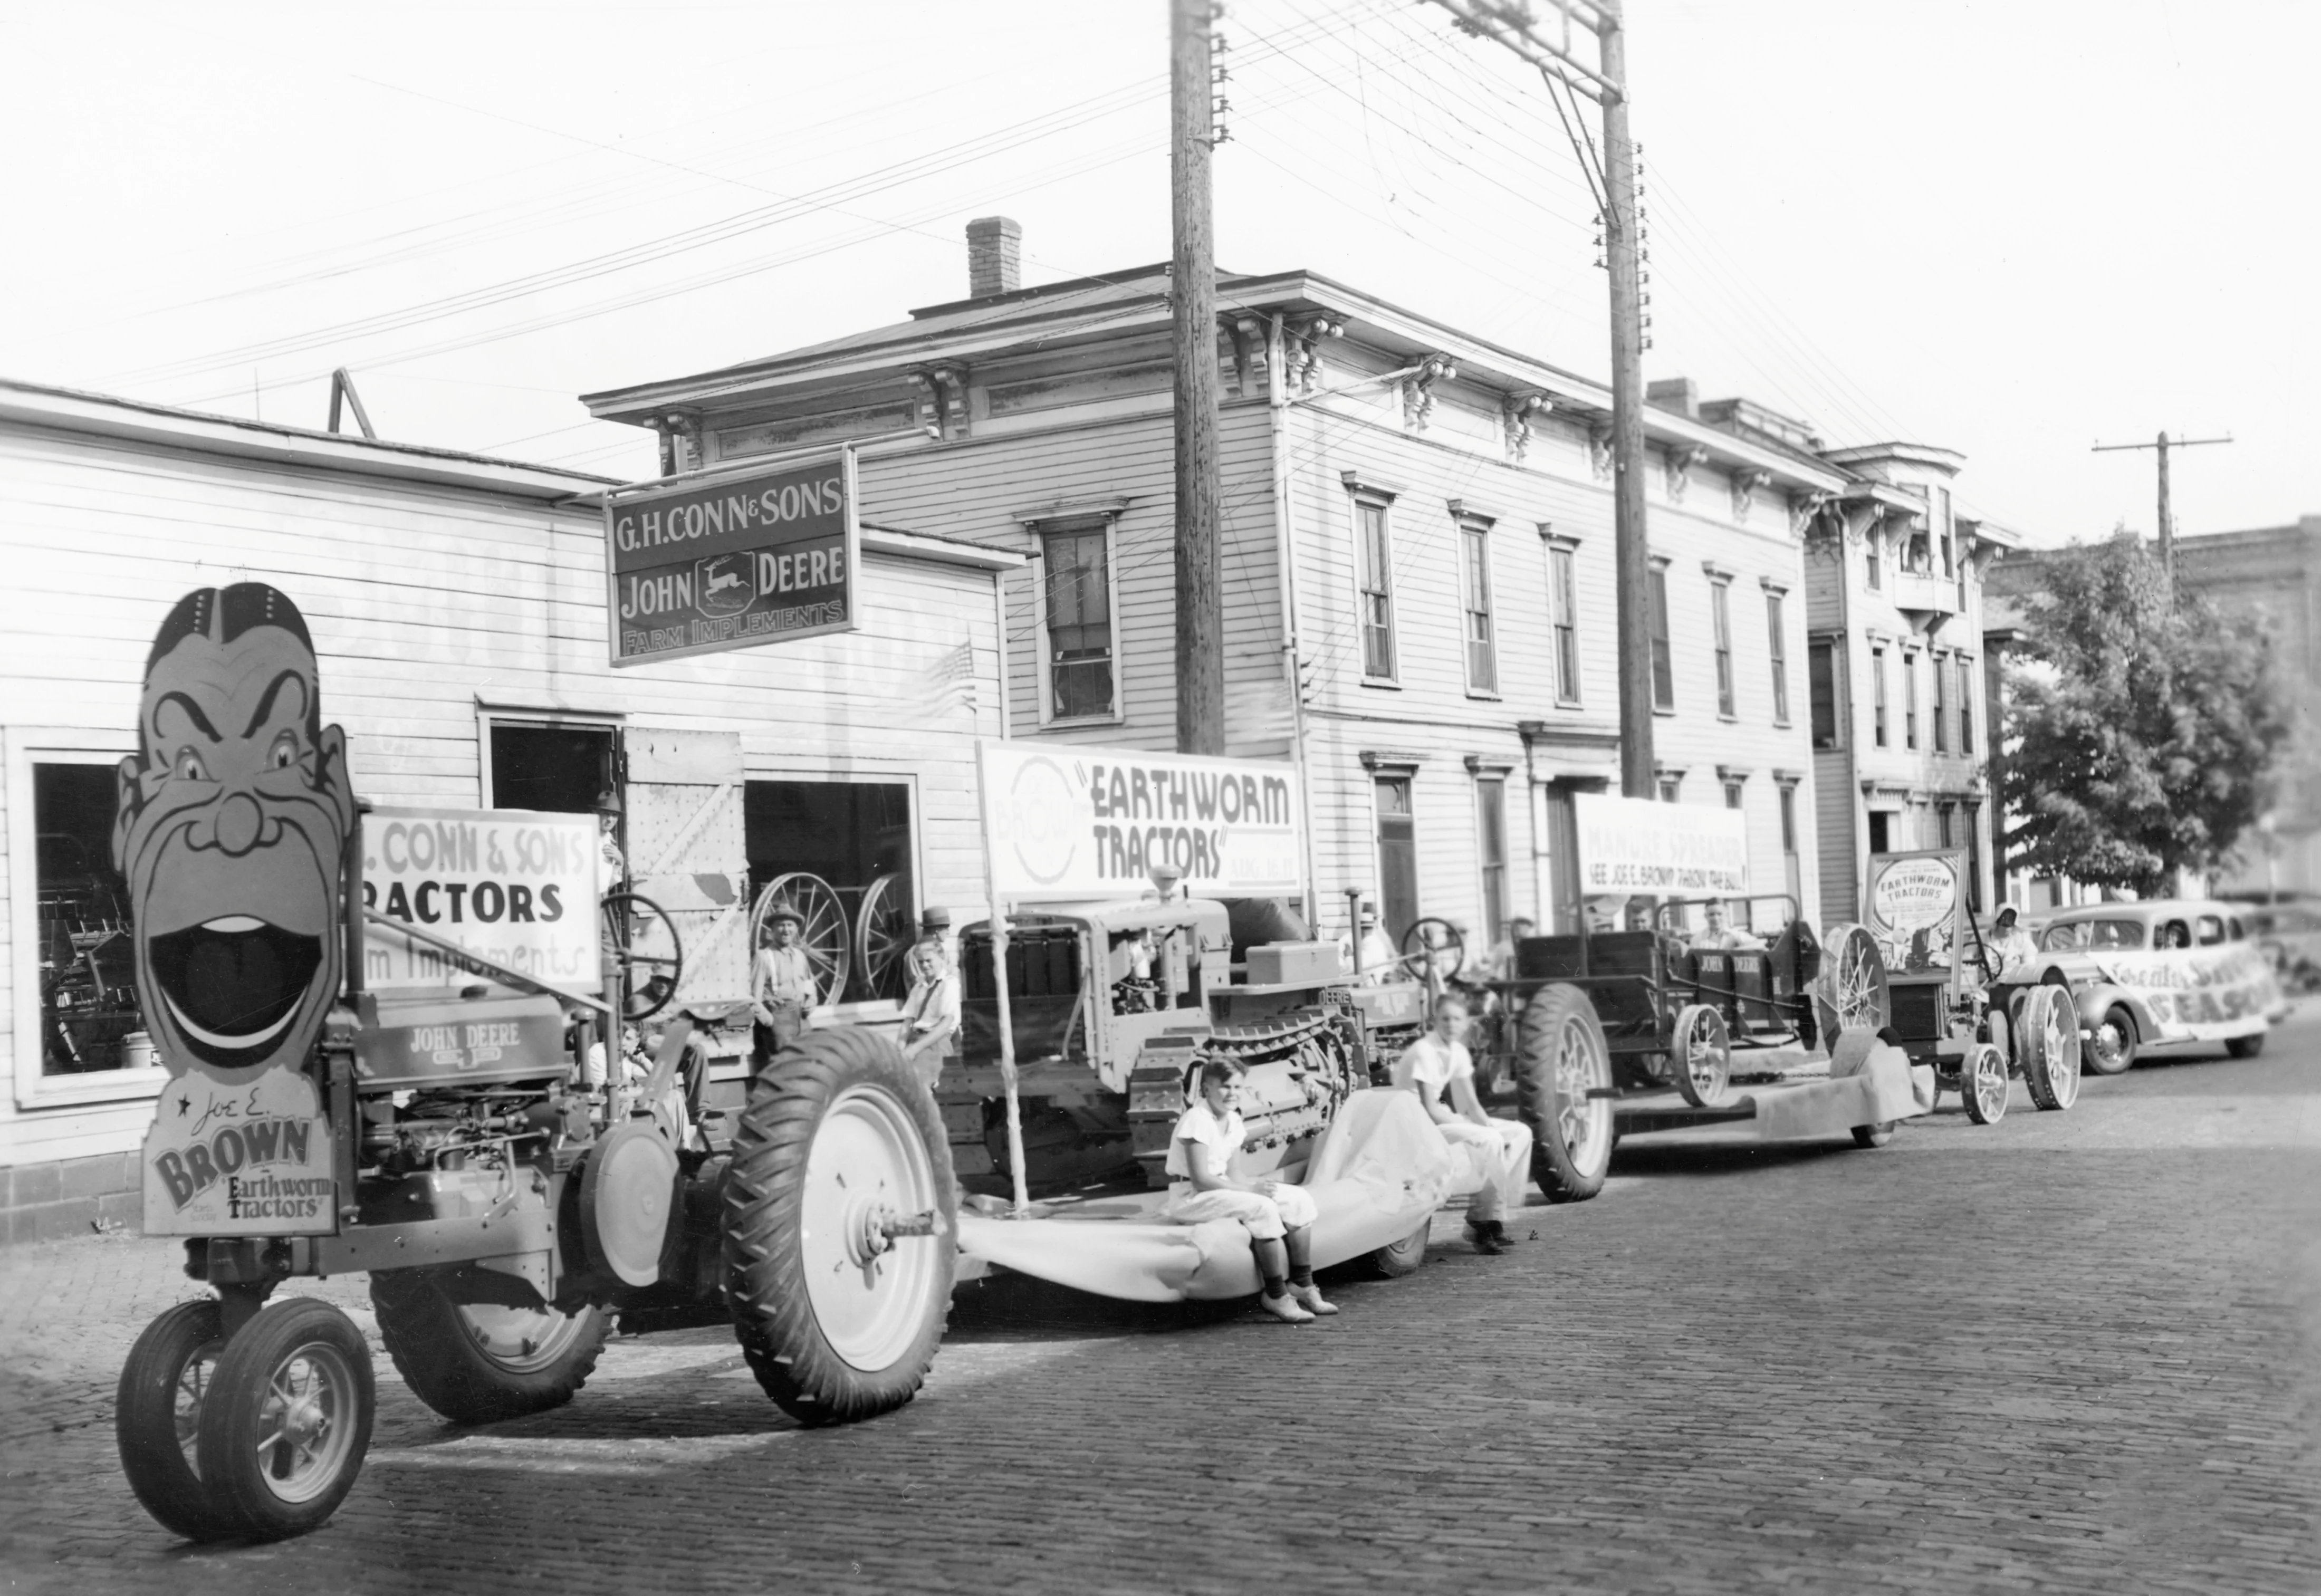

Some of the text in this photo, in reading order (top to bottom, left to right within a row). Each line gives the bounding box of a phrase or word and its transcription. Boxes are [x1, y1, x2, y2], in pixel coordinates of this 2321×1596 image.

[748, 499, 759, 517] &
[760, 477, 842, 526] SONS
[620, 546, 845, 619] JOHN DEERE
[622, 600, 844, 656] FARM IMPLEMENTS
[486, 829, 507, 875] &
[514, 826, 585, 875] SONS
[1589, 863, 1607, 886] SEE
[1611, 863, 1628, 886] JOE
[1880, 874, 1951, 892] EARTHWORM
[1887, 887, 1942, 902] TRACTORS
[1702, 955, 1760, 973] JOHN DEERE
[1318, 989, 1350, 1005] DEERE
[410, 1023, 521, 1053] JOHN DEERE
[245, 1087, 271, 1118] E.
[153, 1118, 310, 1210] BROWN
